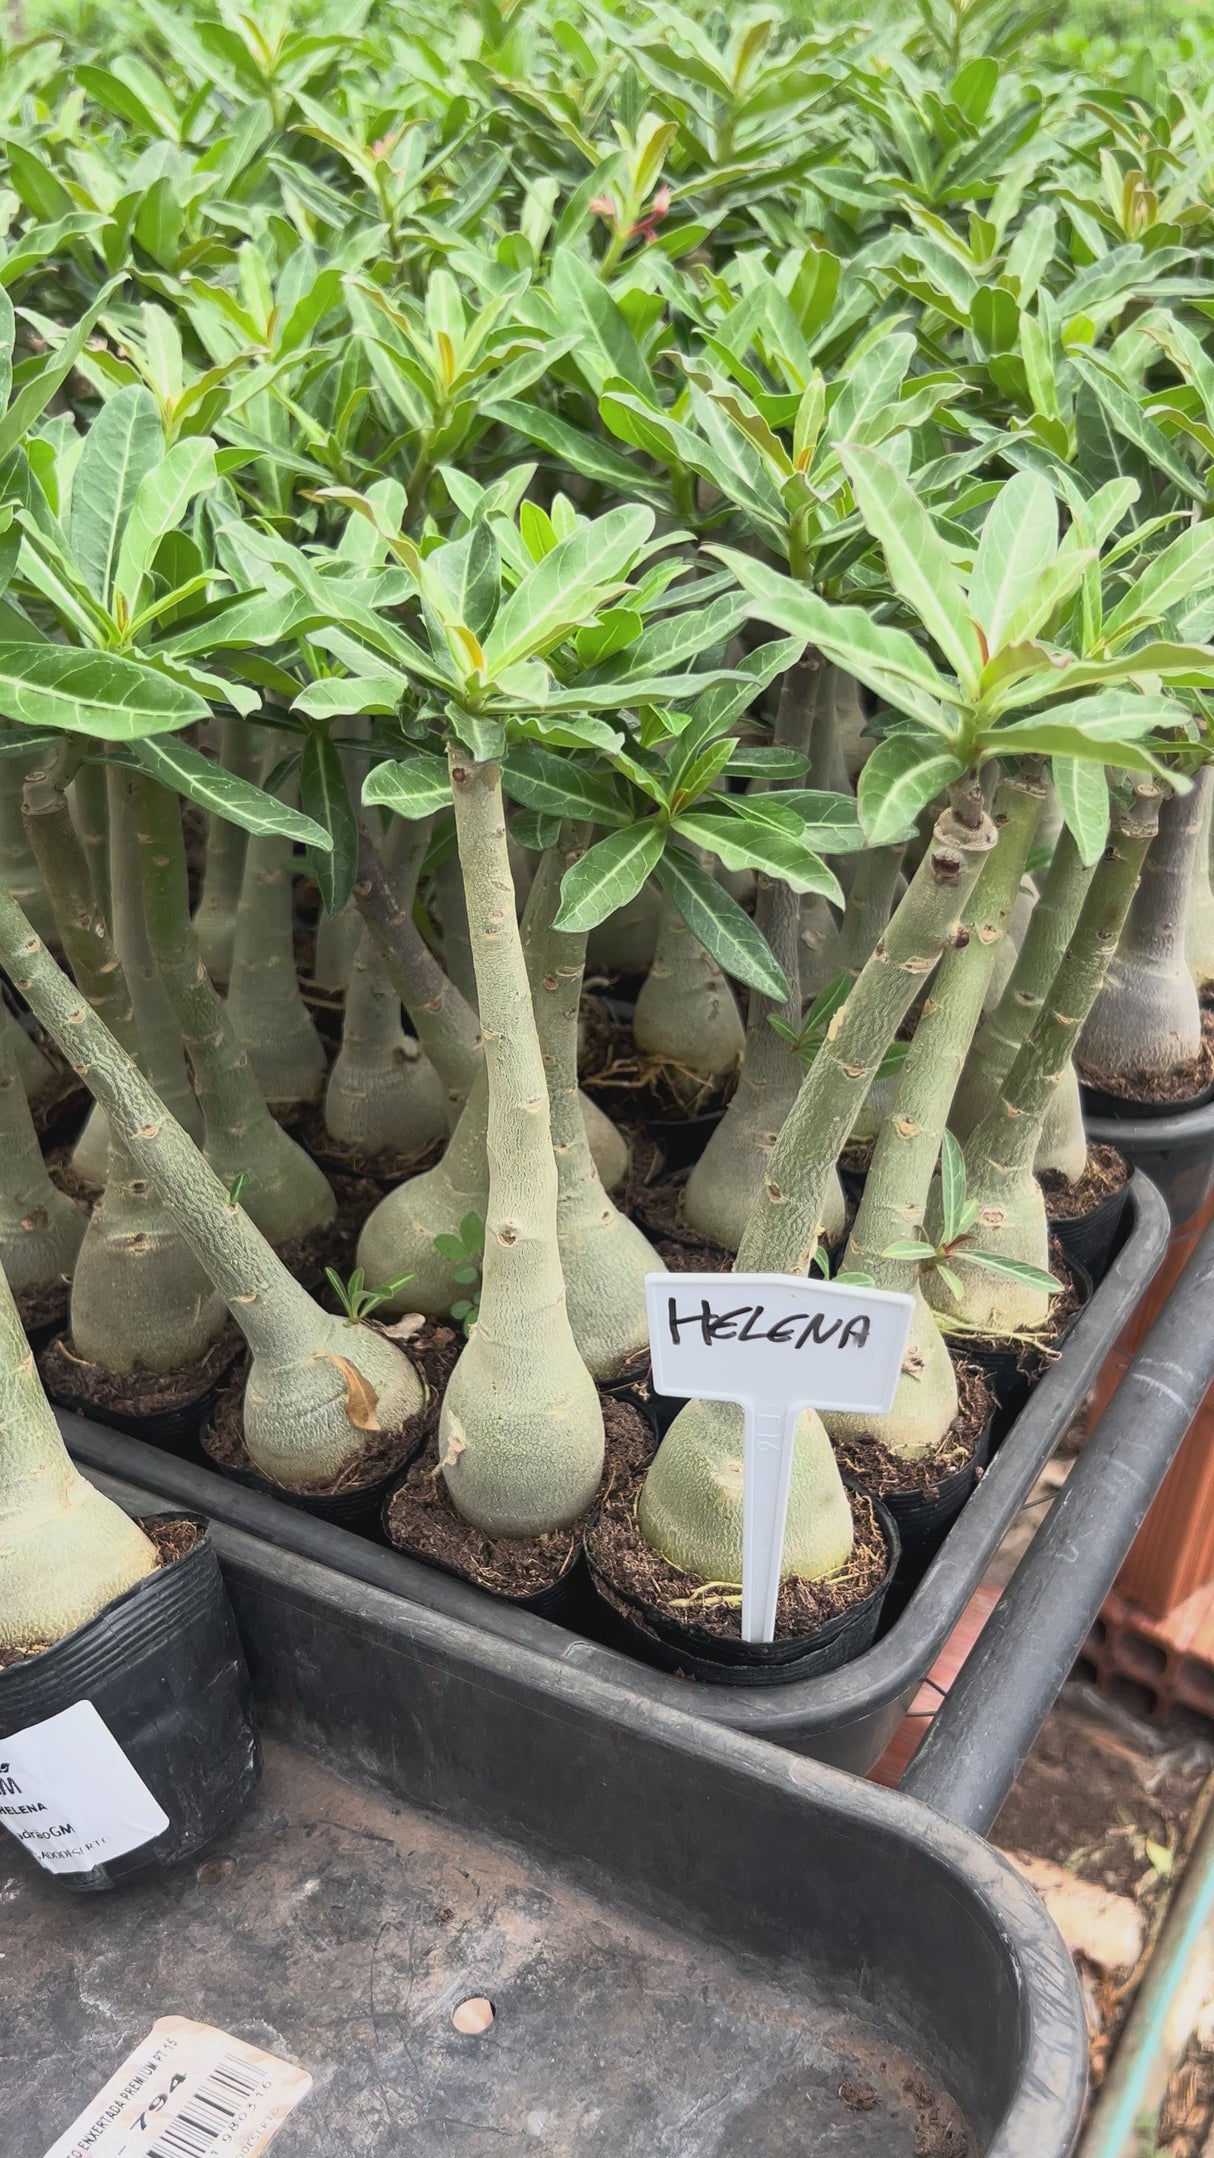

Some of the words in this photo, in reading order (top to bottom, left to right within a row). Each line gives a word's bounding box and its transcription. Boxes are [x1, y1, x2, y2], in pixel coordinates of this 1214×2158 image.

[667, 1297, 871, 1349] HELENA
[0, 1802, 48, 1815] HELENA
[77, 2100, 126, 2151] ENXERTADA
[120, 2061, 159, 2101] PREMIUM
[130, 2072, 187, 2131] 794
